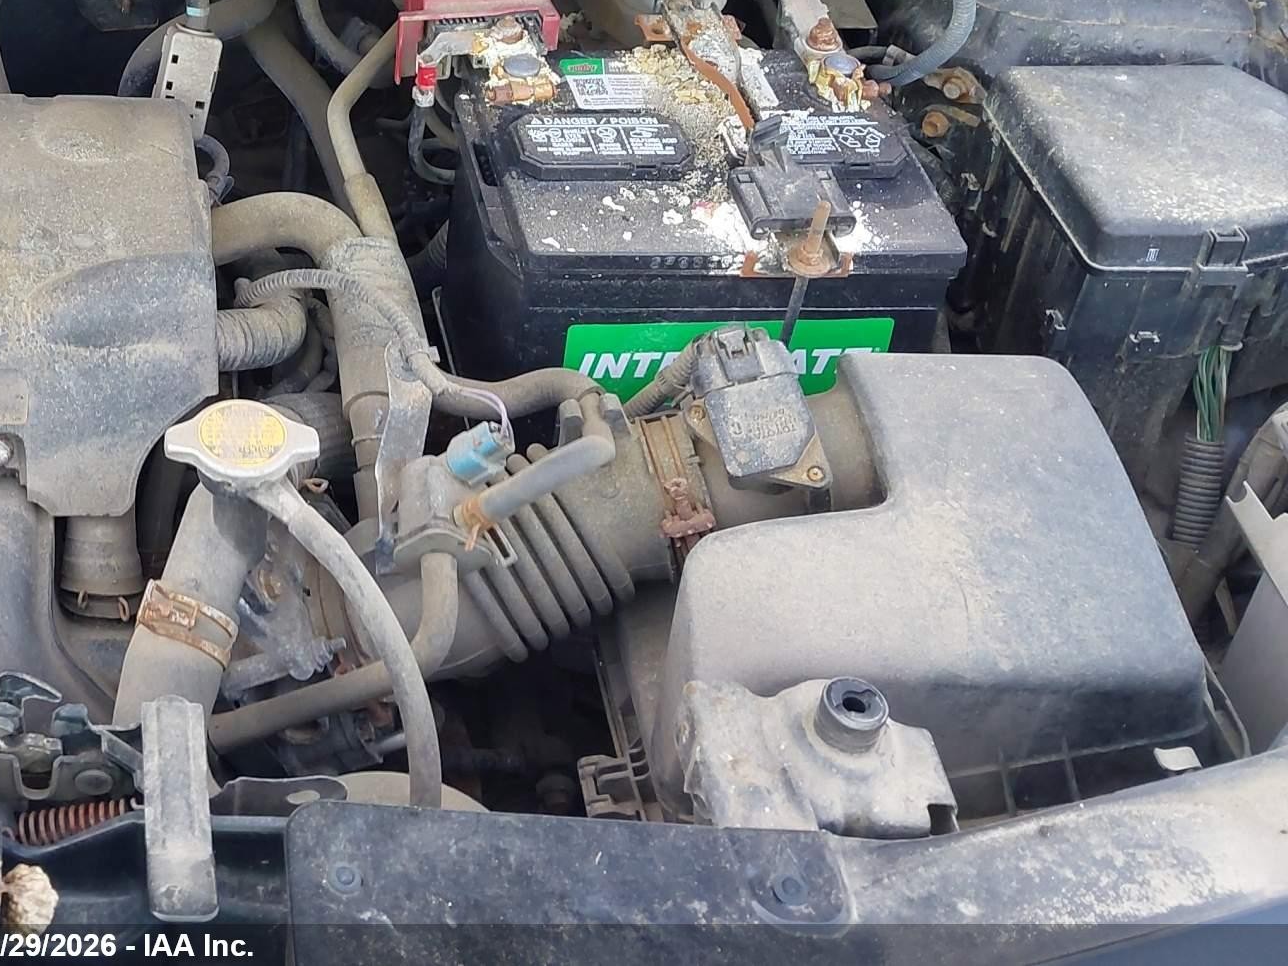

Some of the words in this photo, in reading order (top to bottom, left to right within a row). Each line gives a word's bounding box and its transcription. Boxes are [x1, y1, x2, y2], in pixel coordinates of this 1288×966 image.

[544, 117, 597, 125] DANGER
[599, 117, 607, 125] /
[609, 117, 659, 125] POISON
